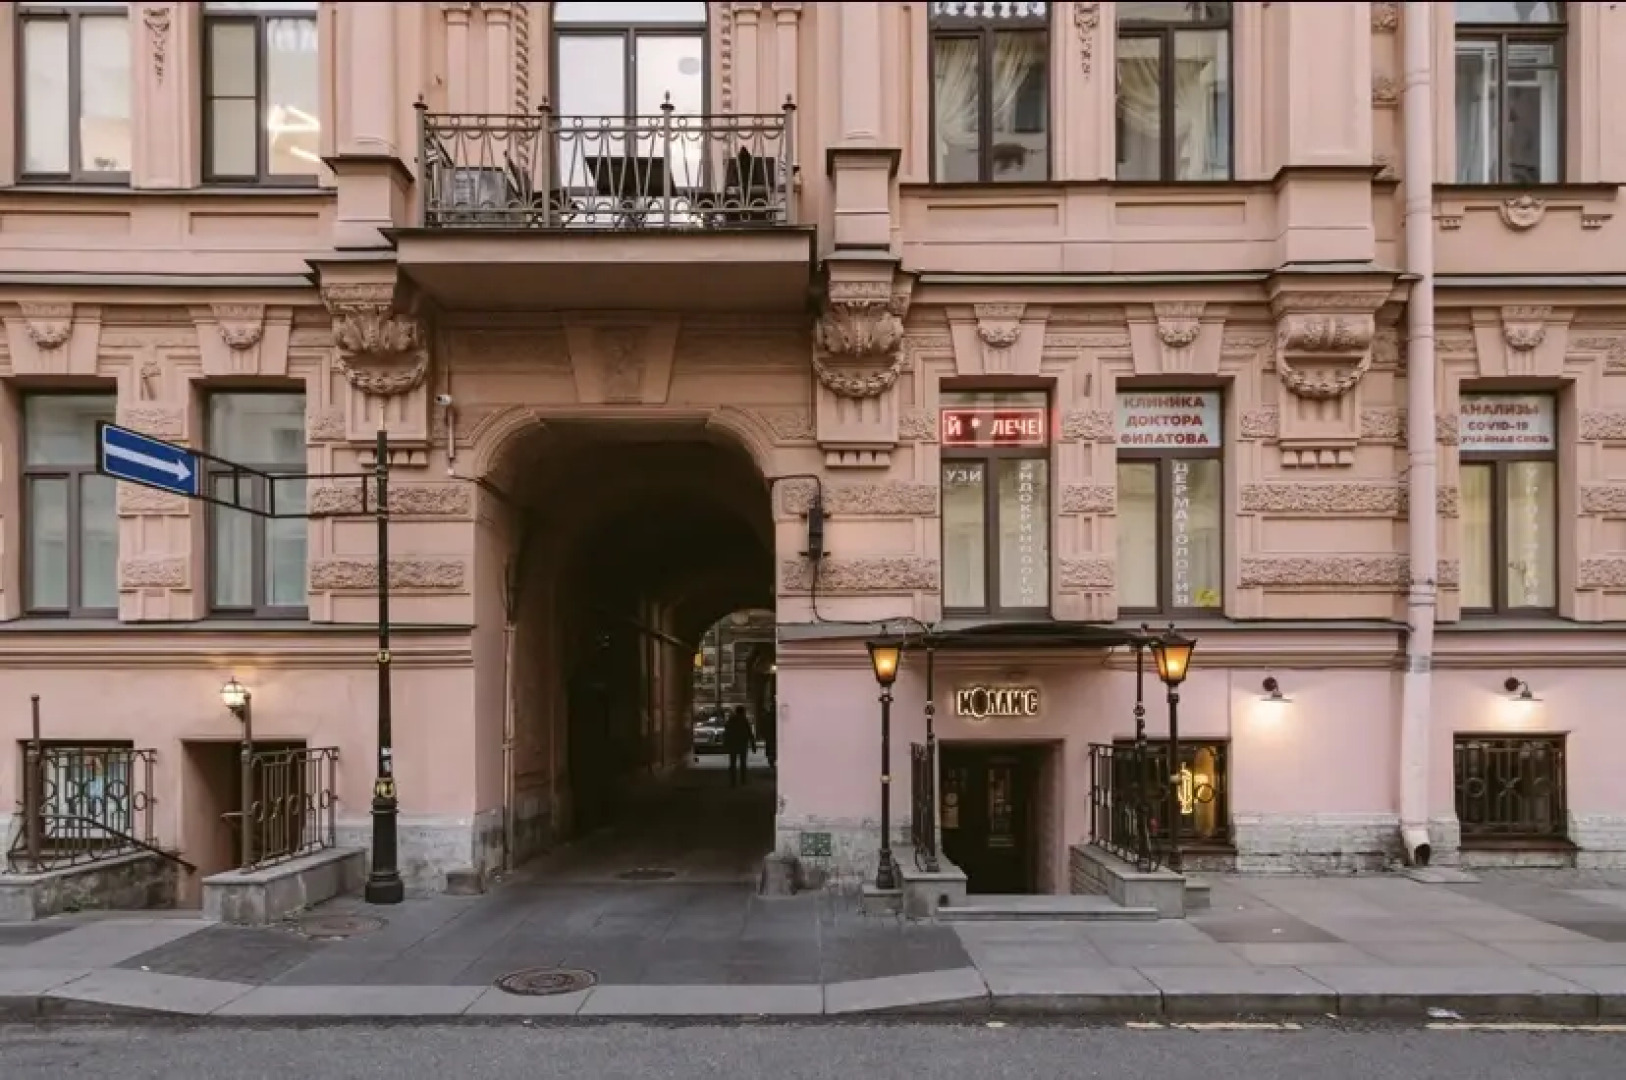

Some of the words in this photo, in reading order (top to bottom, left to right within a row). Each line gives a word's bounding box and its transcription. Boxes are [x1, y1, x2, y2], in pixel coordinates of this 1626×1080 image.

[1123, 396, 1205, 408] КЛИНИКА
[1125, 415, 1203, 428] ДОКТОРА
[1468, 421, 1529, 431] COVID-19
[1120, 433, 1209, 445] ФИЛАТОВА
[946, 470, 982, 482] УЗИ
[1174, 462, 1189, 604] ДЕРМАТОЛОГИЯ
